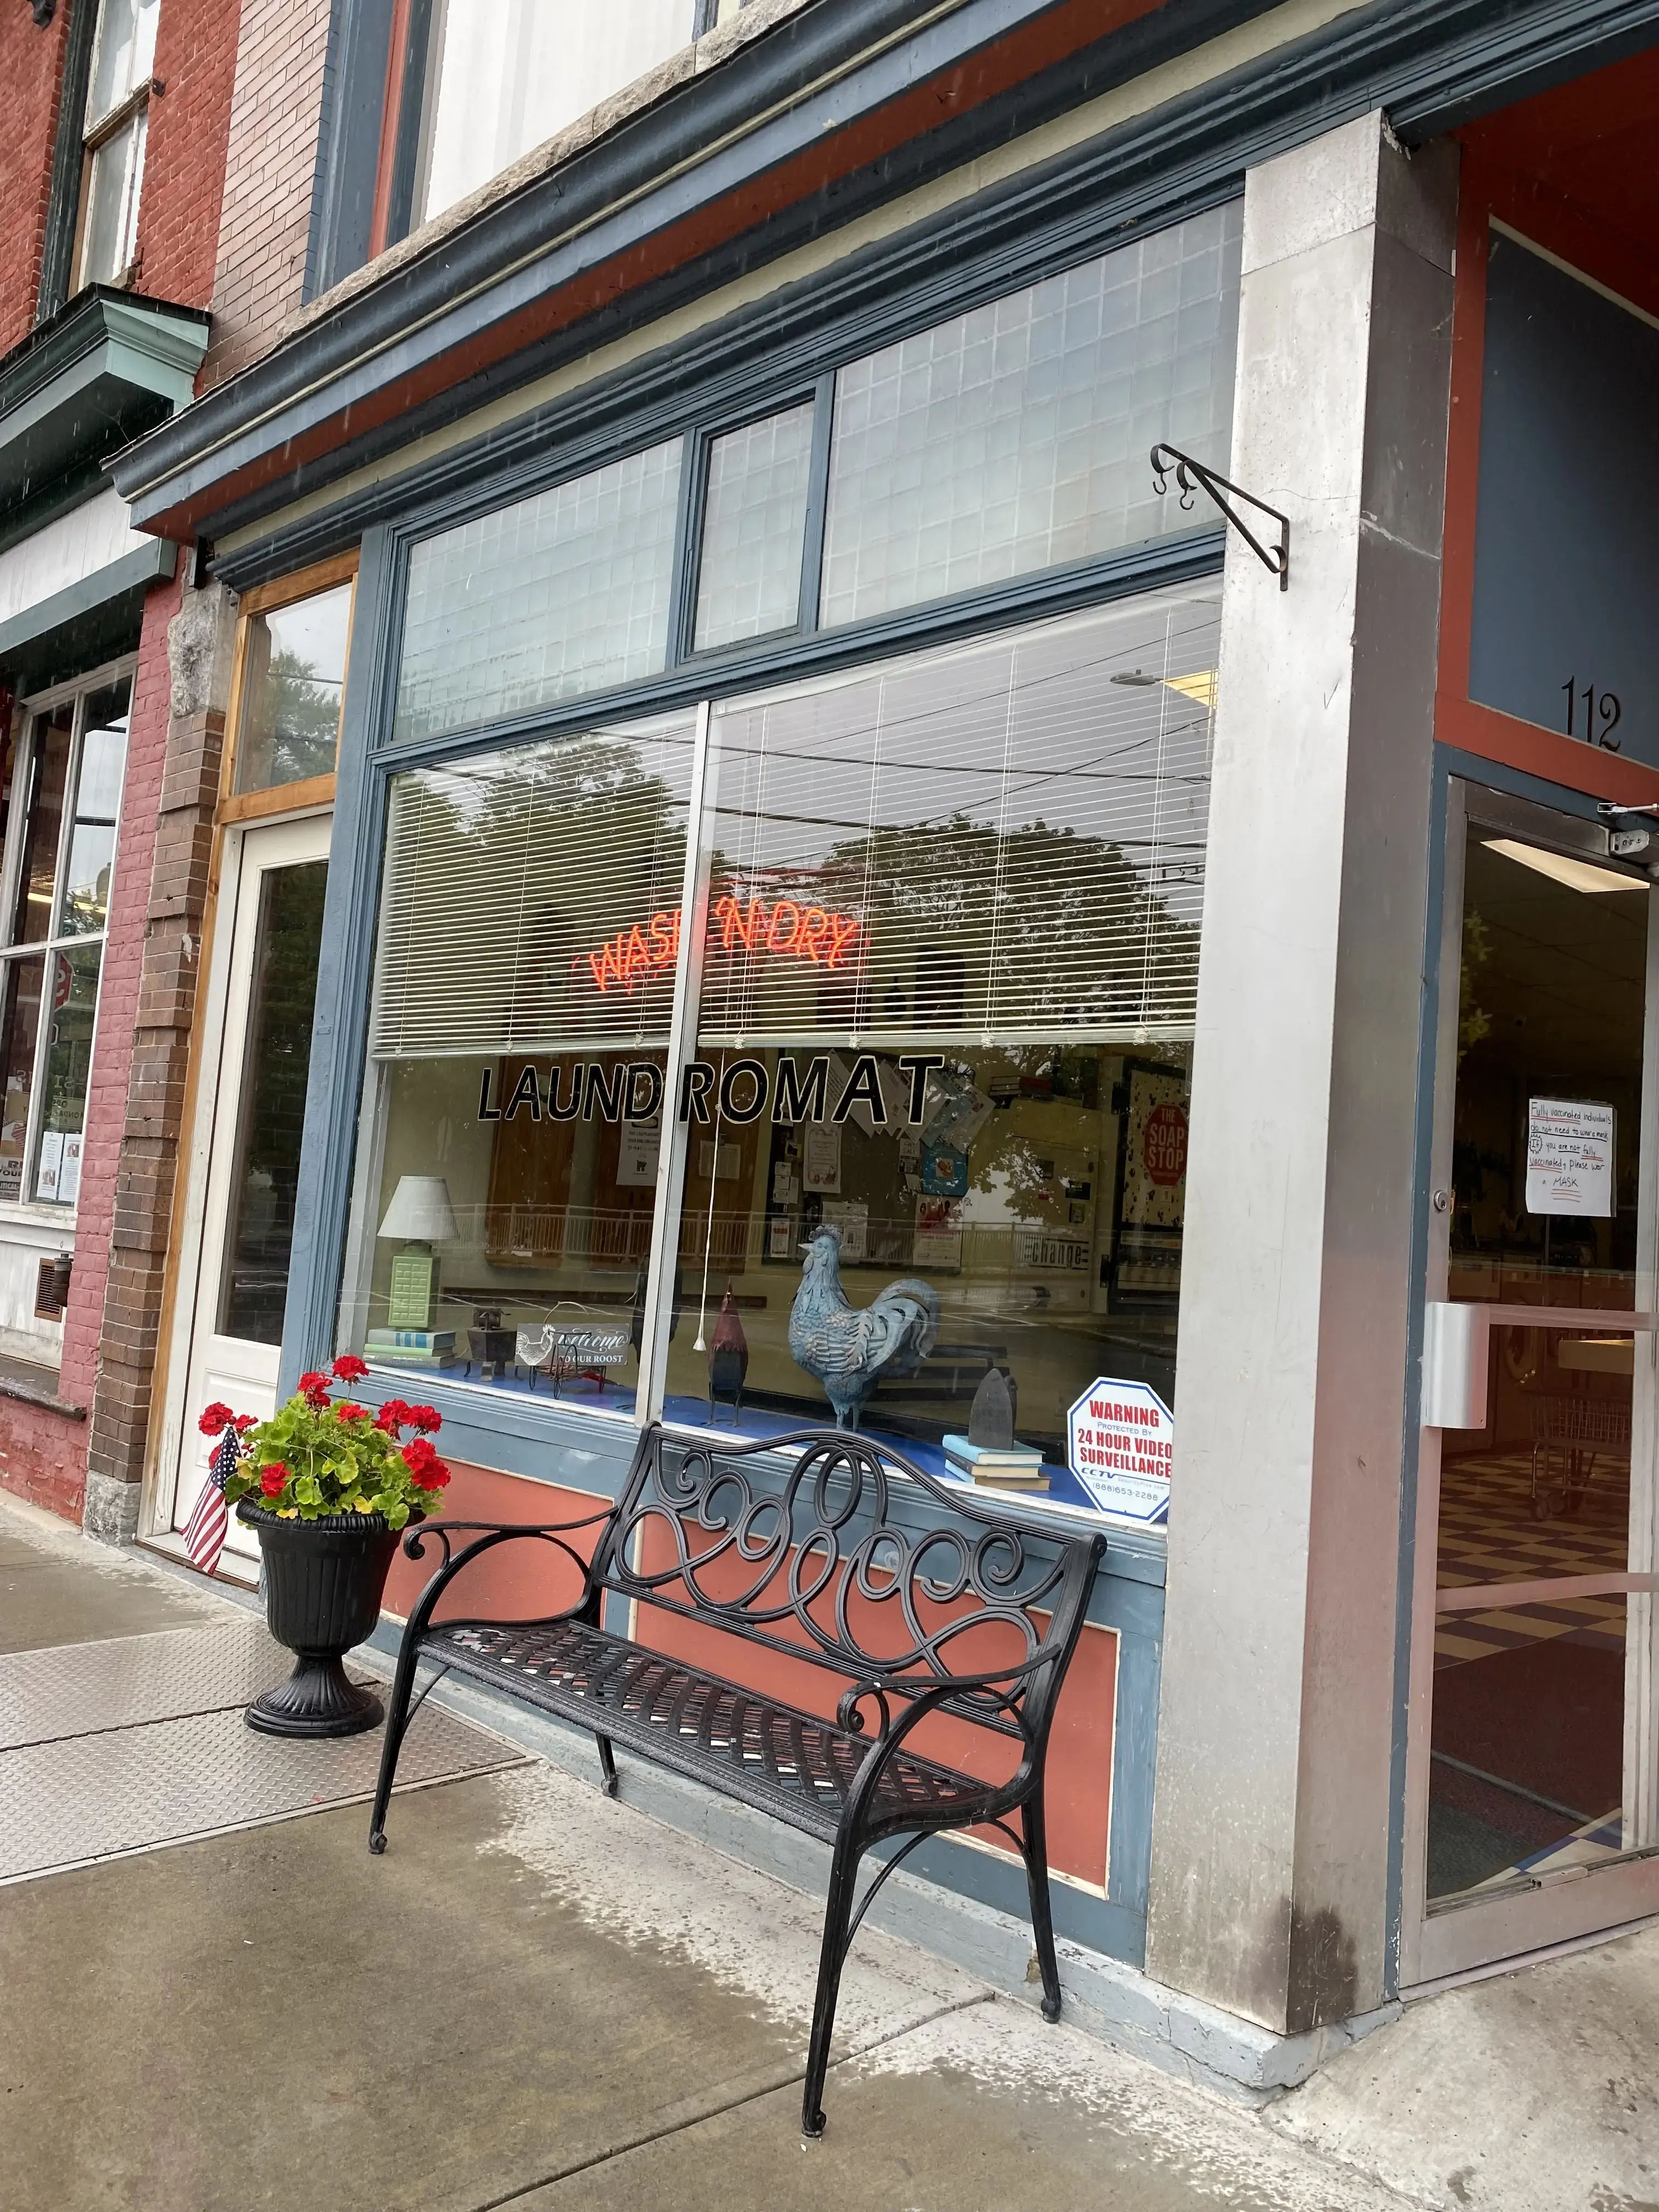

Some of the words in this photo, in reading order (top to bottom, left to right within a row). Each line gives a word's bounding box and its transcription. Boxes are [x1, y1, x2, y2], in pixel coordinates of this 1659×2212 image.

[1561, 675, 1621, 752] 112
[767, 900, 857, 968] DRY
[477, 1054, 945, 1125] LAUNDROMAT
[1161, 1108, 1176, 1122] THE
[1531, 1102, 1548, 1122] Fully
[1149, 1122, 1185, 1148] SOAP
[1531, 1121, 1539, 1131] do
[1542, 1125, 1553, 1133] not
[1555, 1126, 1570, 1134] need
[1596, 1130, 1608, 1139] mask
[1148, 1146, 1184, 1170] STOP
[1546, 1143, 1556, 1153] you
[1583, 1144, 1596, 1159] fully
[1553, 1177, 1579, 1188] MASK
[1089, 1400, 1159, 1427] WARNING
[1078, 1428, 1093, 1444] 24
[1096, 1431, 1131, 1452] HOUR
[1135, 1437, 1172, 1459] VIDEO
[1080, 1447, 1172, 1478] SURVEILLANCE
[1081, 1467, 1115, 1479] CCTV
[1092, 1481, 1158, 1501] (888)653-2288
